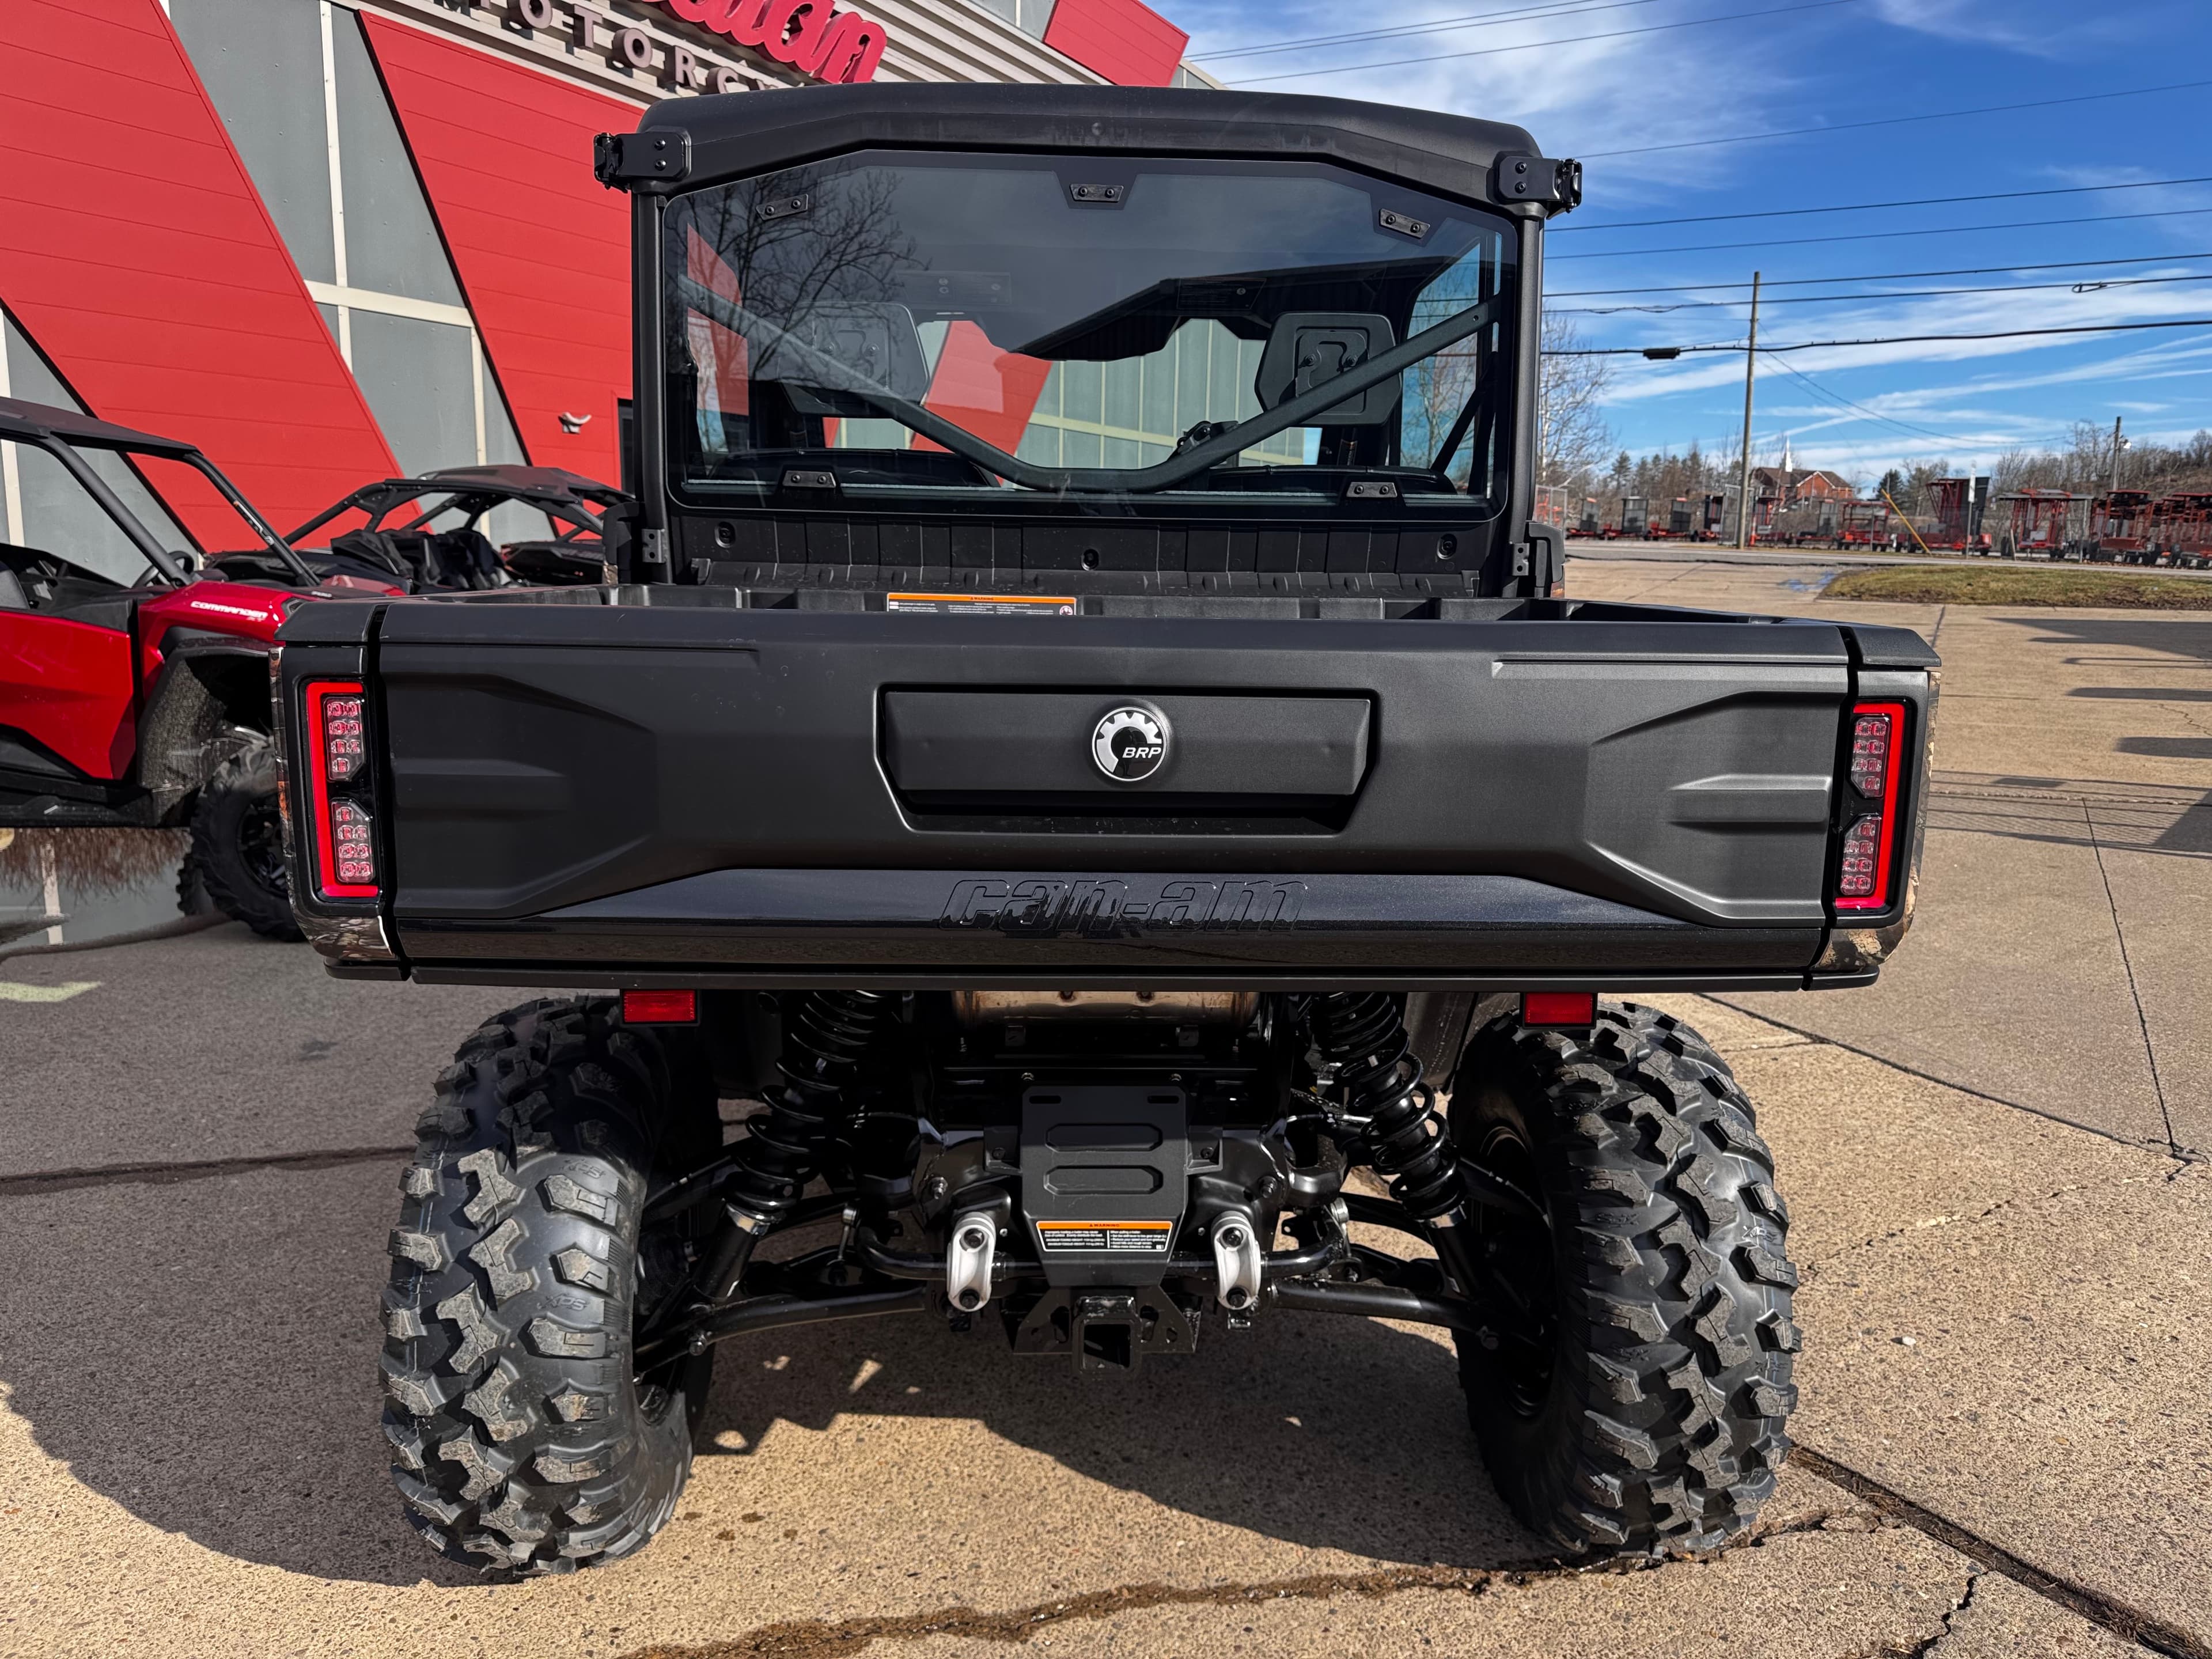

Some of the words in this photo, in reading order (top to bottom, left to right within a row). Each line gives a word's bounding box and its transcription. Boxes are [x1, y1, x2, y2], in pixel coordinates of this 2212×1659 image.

[191, 600, 268, 619] COMMANDER
[1122, 747, 1162, 759] BRP
[938, 879, 1308, 931] can-am
[537, 1293, 588, 1310] XPS
